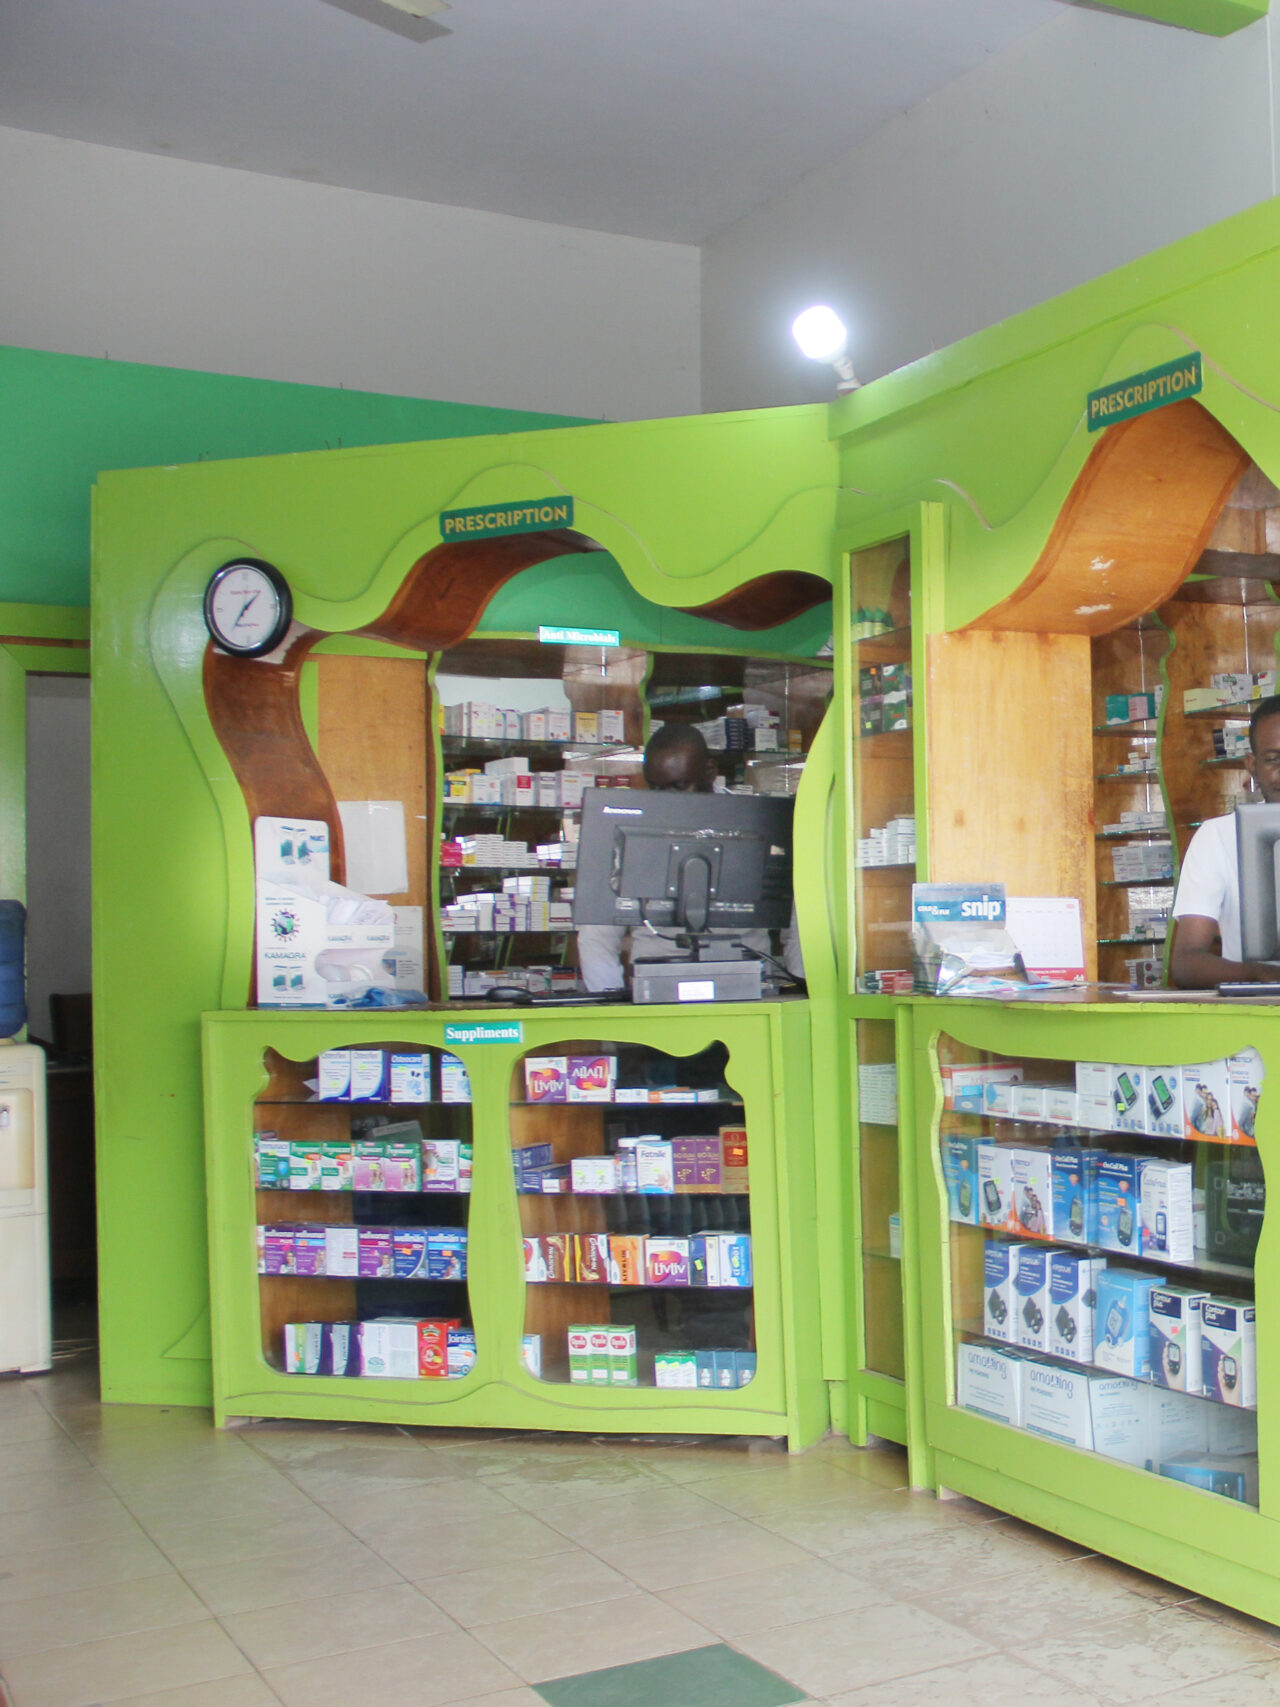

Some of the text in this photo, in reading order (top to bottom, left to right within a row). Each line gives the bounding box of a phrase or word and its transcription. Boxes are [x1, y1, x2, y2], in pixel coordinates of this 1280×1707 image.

[1092, 366, 1197, 419] PRESCRIPTION
[443, 505, 568, 535] PRESCRIPTION
[543, 631, 617, 644] Anti Microbials
[961, 895, 1001, 920] snip
[264, 952, 306, 960] KAMAGRA
[446, 1026, 519, 1042] Suppliments
[1153, 1292, 1172, 1303] Contour
[1153, 1300, 1164, 1308] plus
[1205, 1304, 1226, 1315] Contour
[1205, 1312, 1217, 1321] plus
